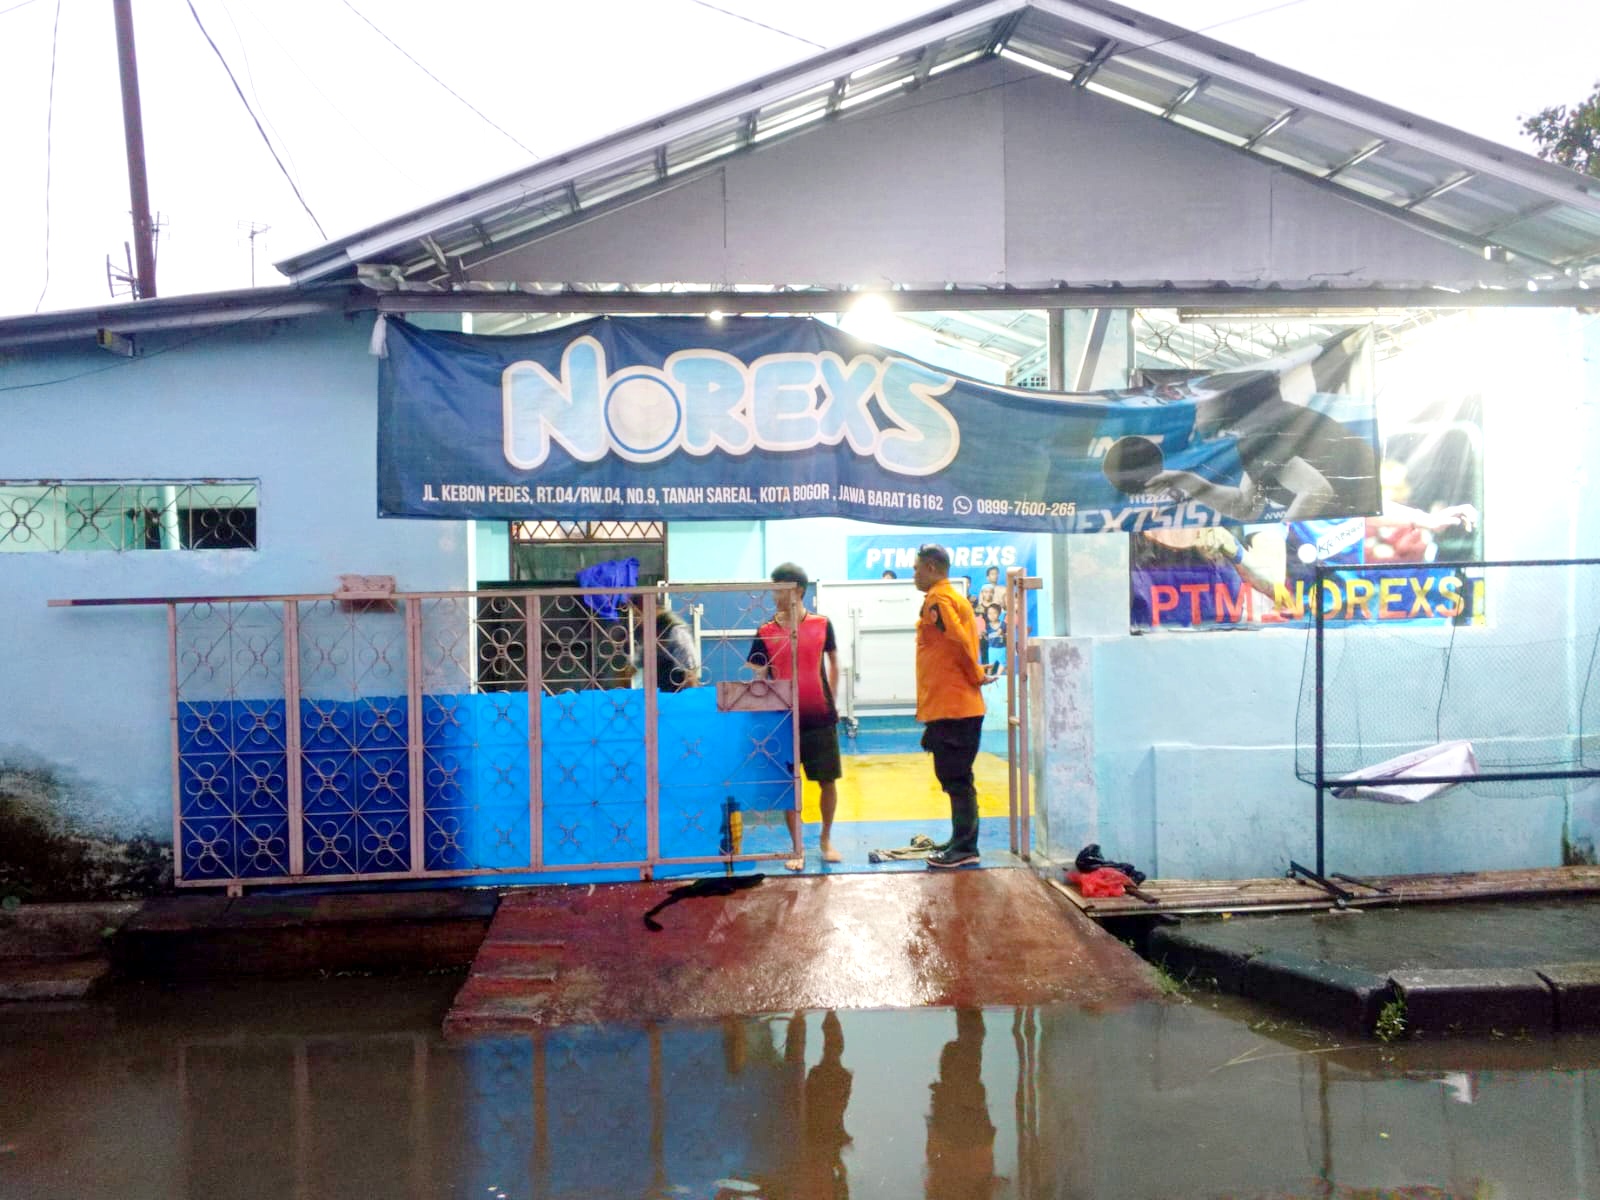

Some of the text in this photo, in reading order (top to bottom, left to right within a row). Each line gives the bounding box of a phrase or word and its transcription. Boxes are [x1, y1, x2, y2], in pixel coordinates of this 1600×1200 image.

[423, 484, 439, 502] JL.
[441, 485, 486, 503] KEBON
[488, 486, 534, 505] PEDES,
[627, 487, 659, 506] NO.9,
[662, 487, 703, 504] TANAH
[706, 486, 757, 504] SAREAL,
[760, 486, 790, 503] KOTA
[793, 483, 829, 501] BOGOR
[839, 485, 866, 505] JAWA
[977, 499, 1076, 516] 0899-7500-265
[865, 547, 917, 569] PTM
[1151, 583, 1254, 627] PTM
